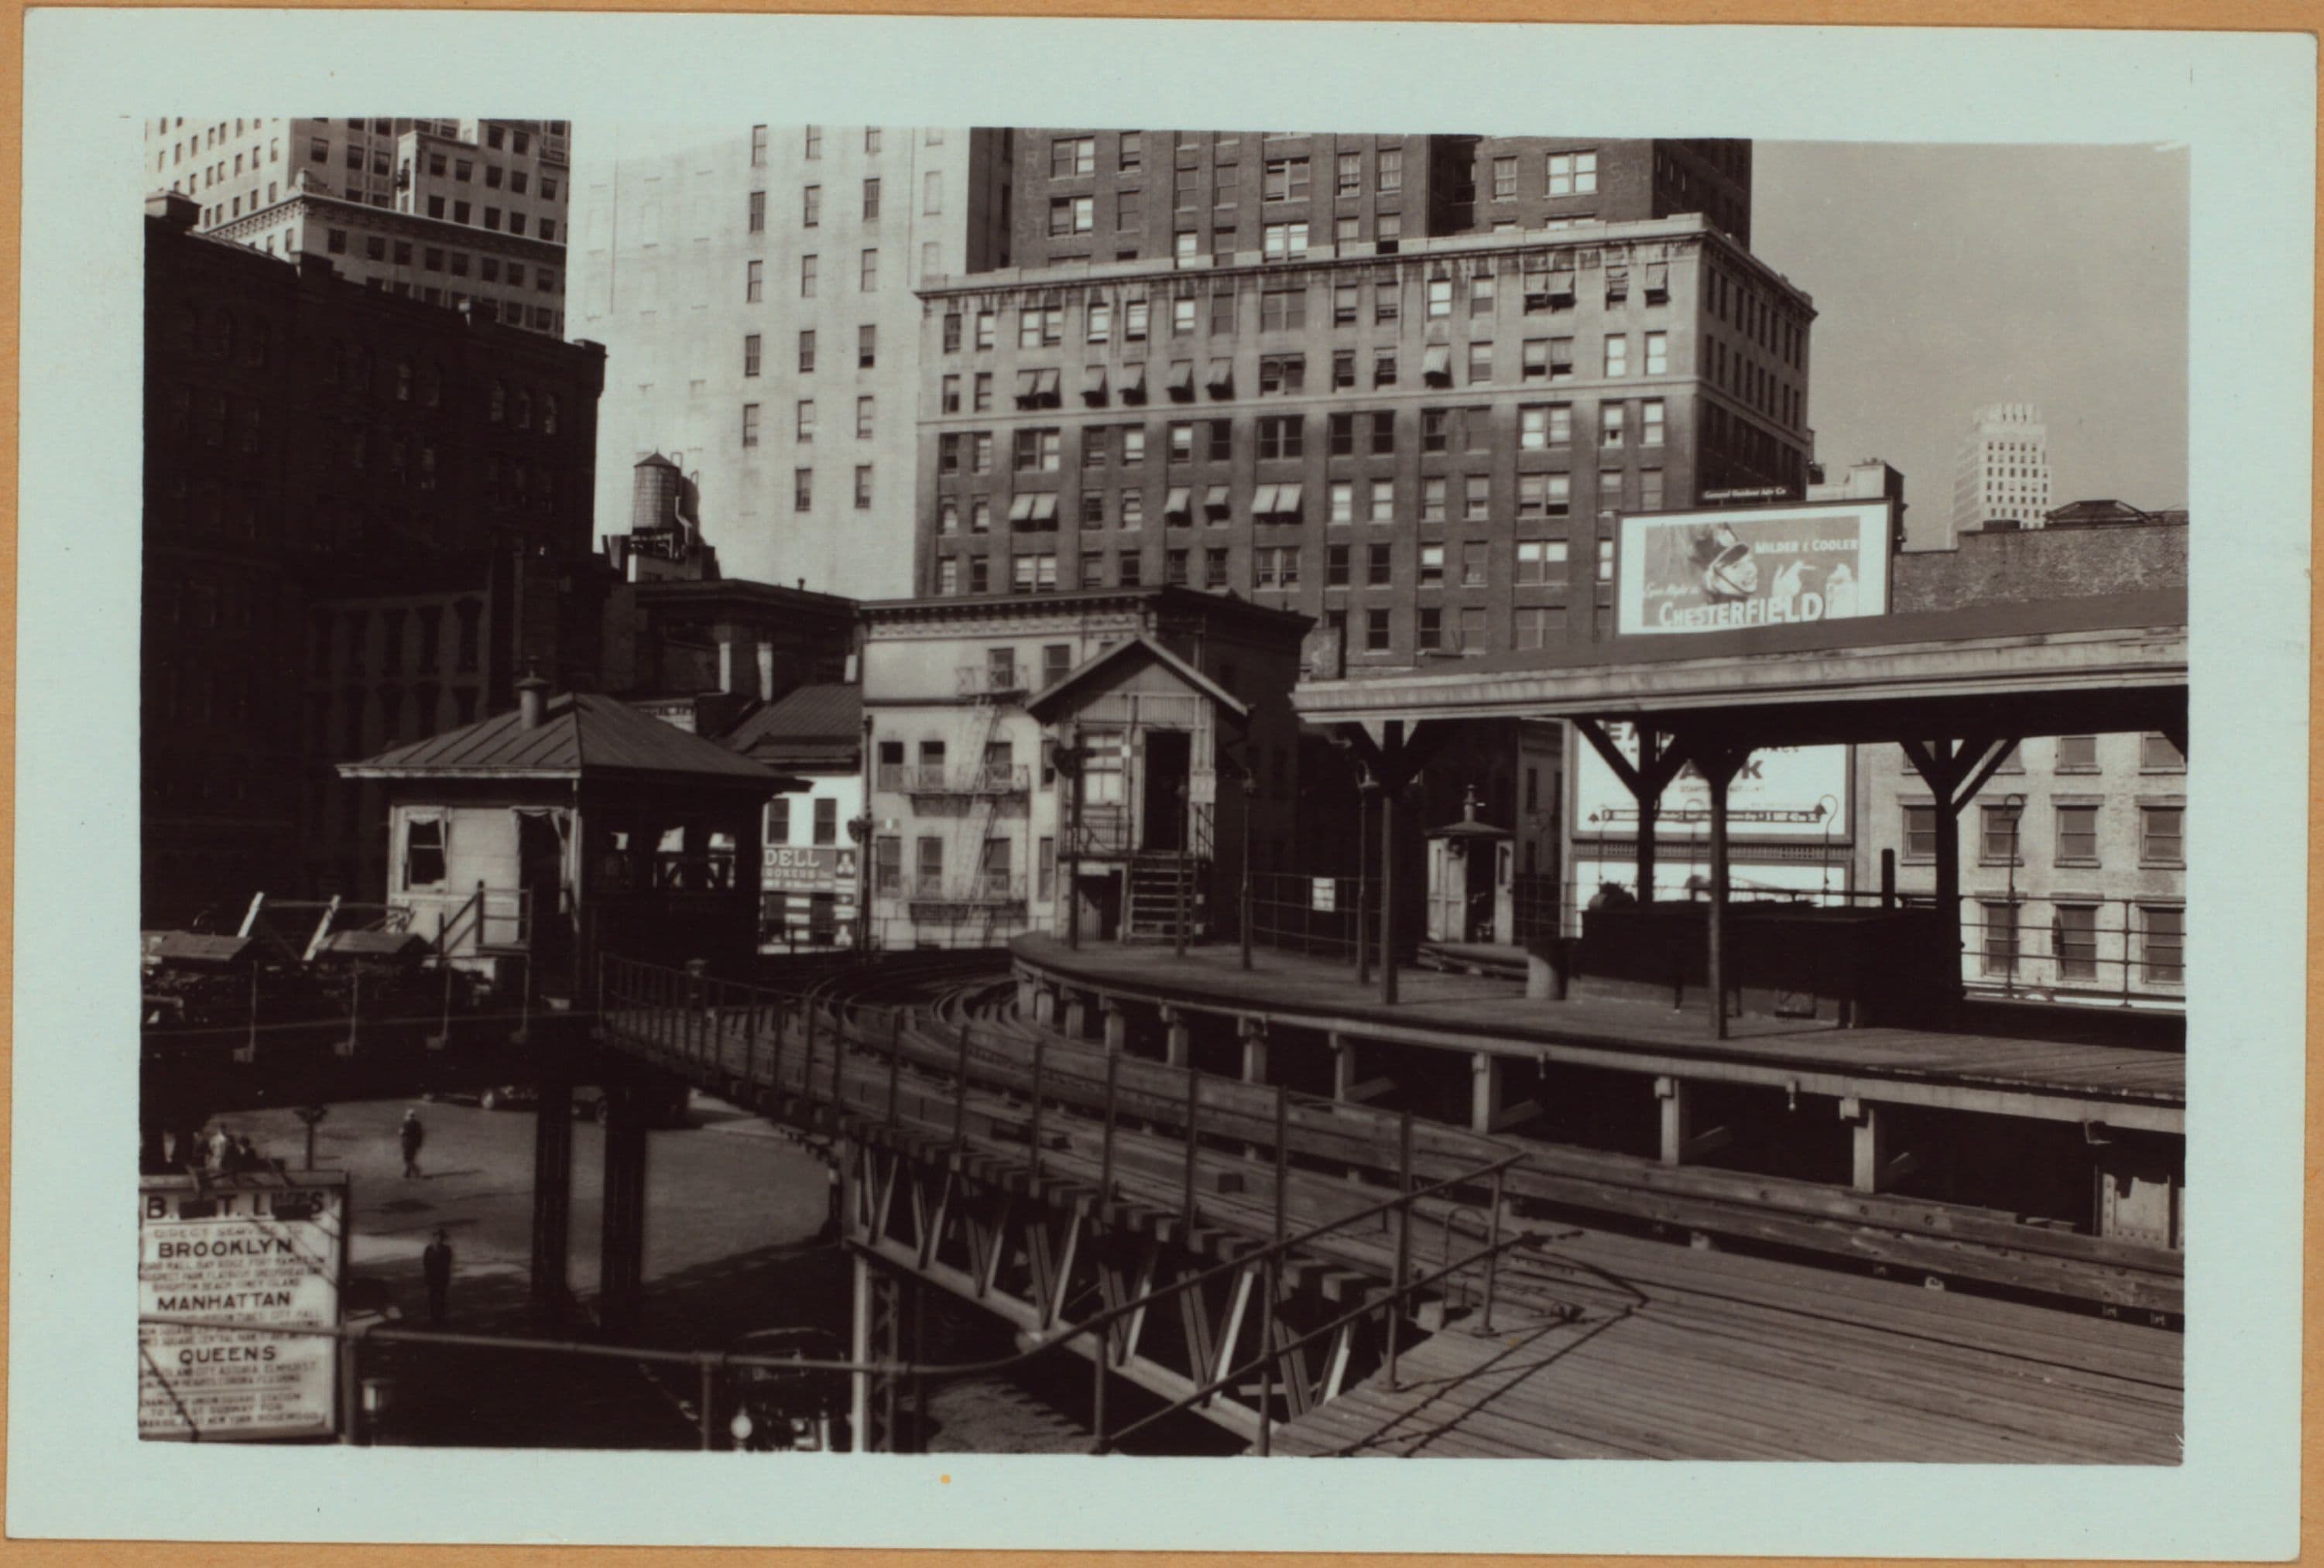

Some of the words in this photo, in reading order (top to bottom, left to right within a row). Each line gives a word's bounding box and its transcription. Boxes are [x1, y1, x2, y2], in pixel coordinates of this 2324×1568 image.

[1755, 540, 1798, 554] MILDER
[1812, 538, 1859, 553] COOLER
[763, 849, 820, 868] DELL
[158, 1238, 293, 1258] BROOKLYN
[157, 1292, 291, 1310] MANHATTAN
[178, 1346, 276, 1364] QUEENS
